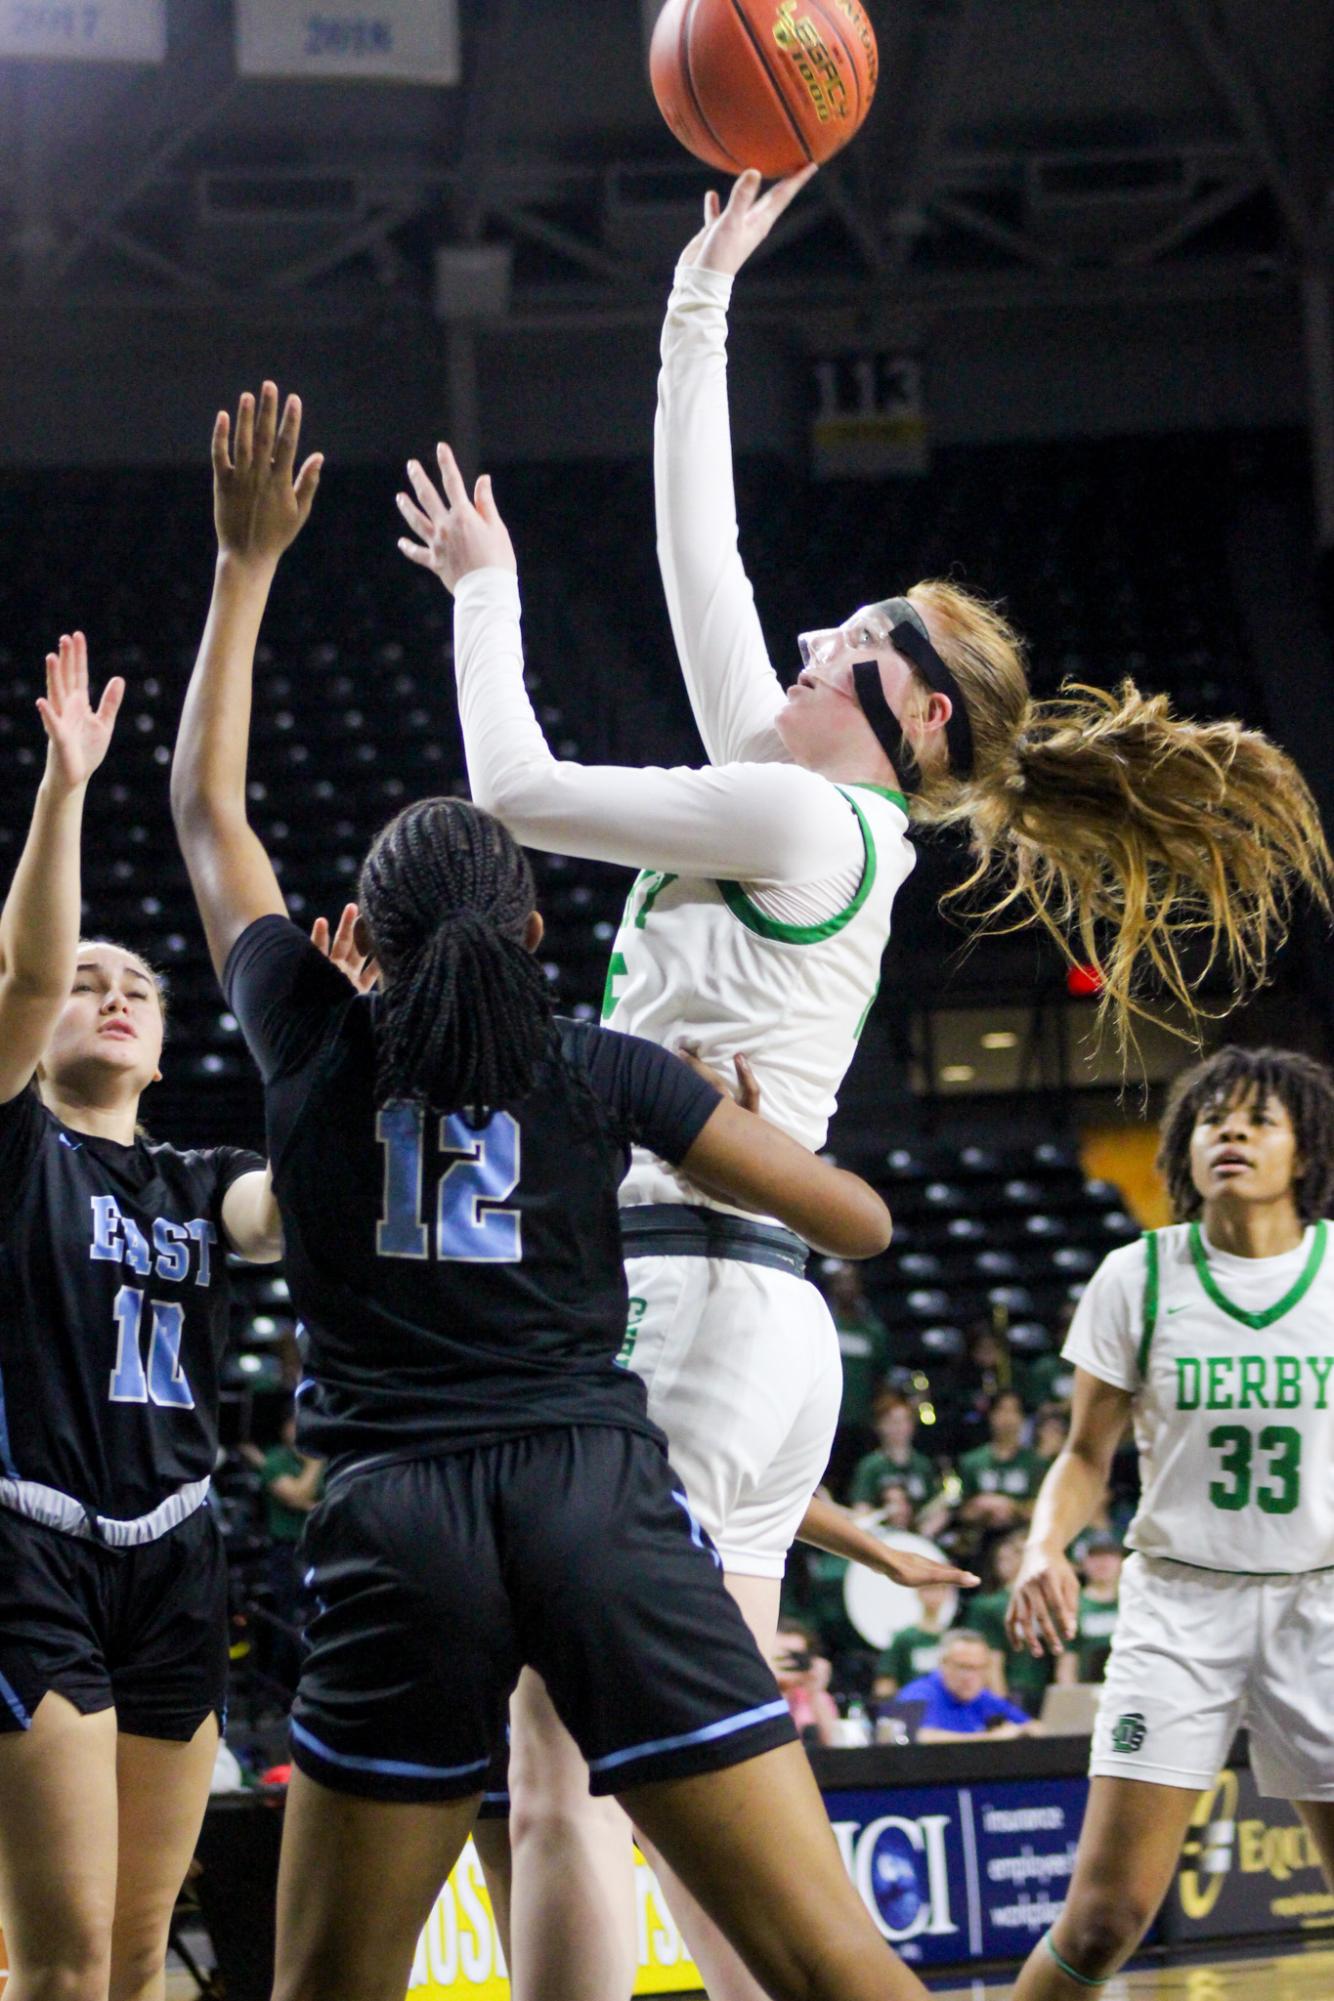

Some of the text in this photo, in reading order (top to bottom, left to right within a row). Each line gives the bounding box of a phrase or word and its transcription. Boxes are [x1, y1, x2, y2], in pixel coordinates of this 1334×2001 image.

[375, 1099, 523, 1263] 12
[90, 1195, 218, 1287] EAST
[1175, 1355, 1334, 1410] DERBY
[1208, 1424, 1302, 1514] 33
